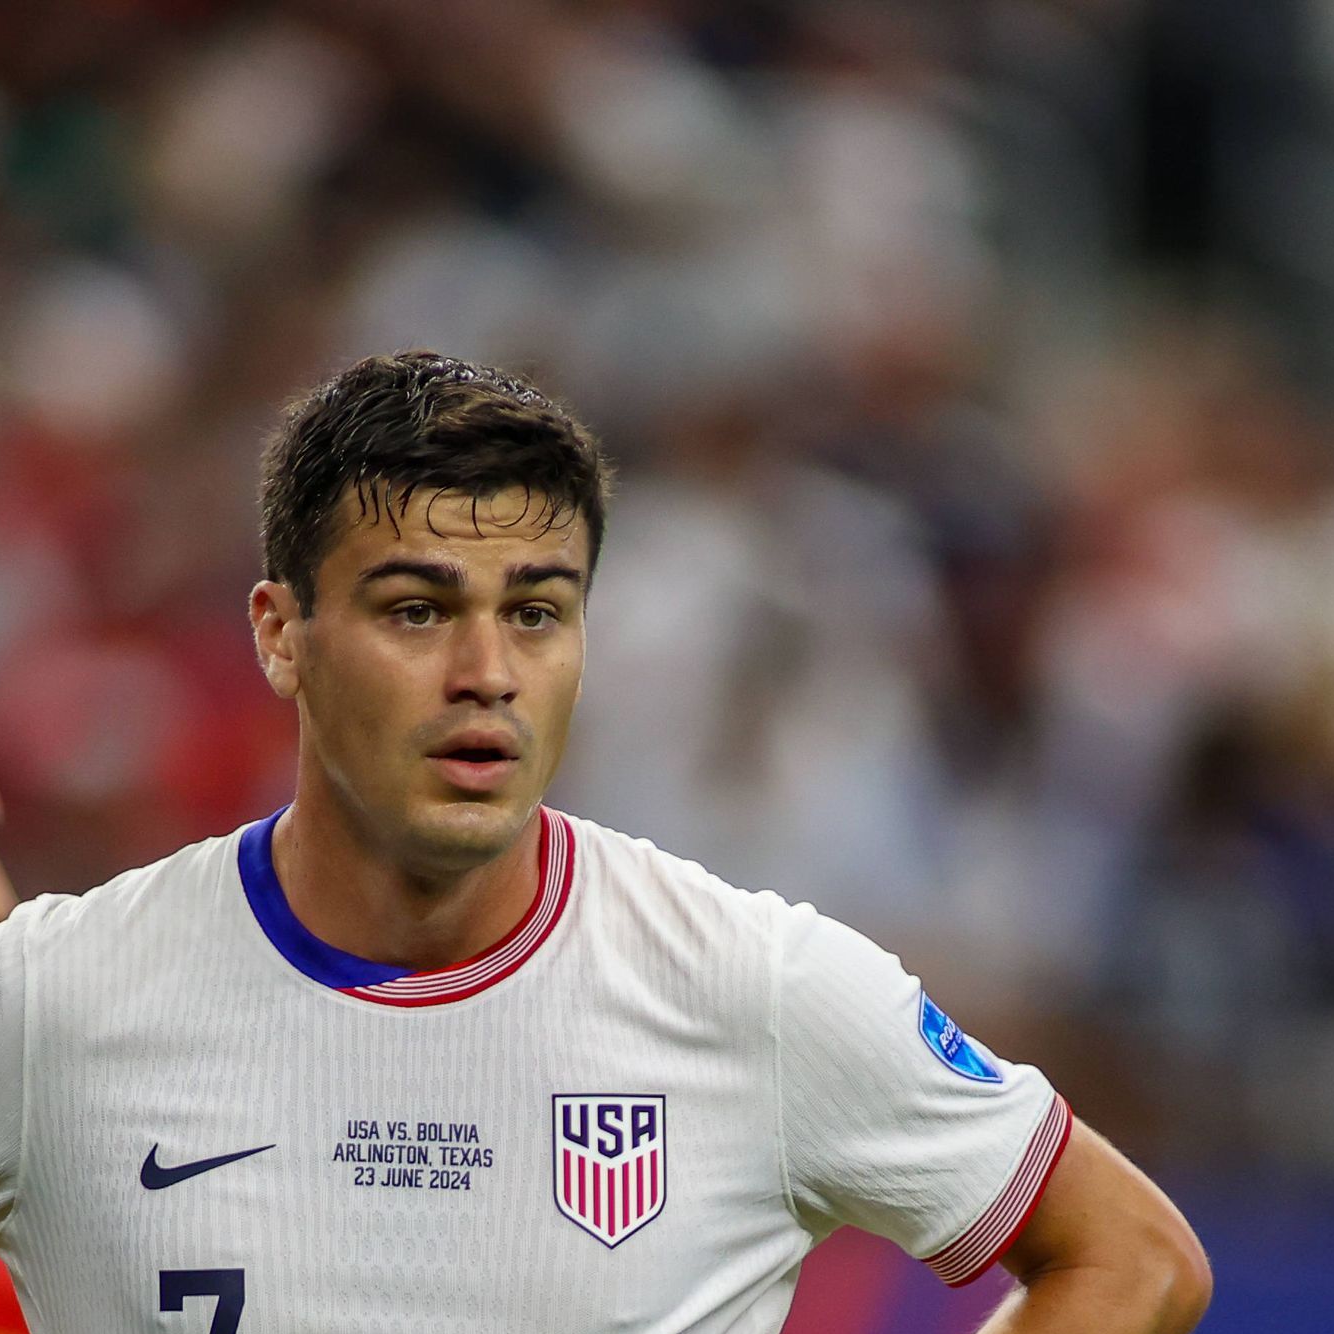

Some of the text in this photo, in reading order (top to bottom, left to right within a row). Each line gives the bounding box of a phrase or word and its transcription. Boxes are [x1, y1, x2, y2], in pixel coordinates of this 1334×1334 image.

[347, 1120, 479, 1143] USA VS. BOLIVIA
[562, 1103, 657, 1158] USA
[333, 1142, 494, 1168] ARLINGTON, TEXAS
[354, 1166, 471, 1190] 23 JUNE 2024
